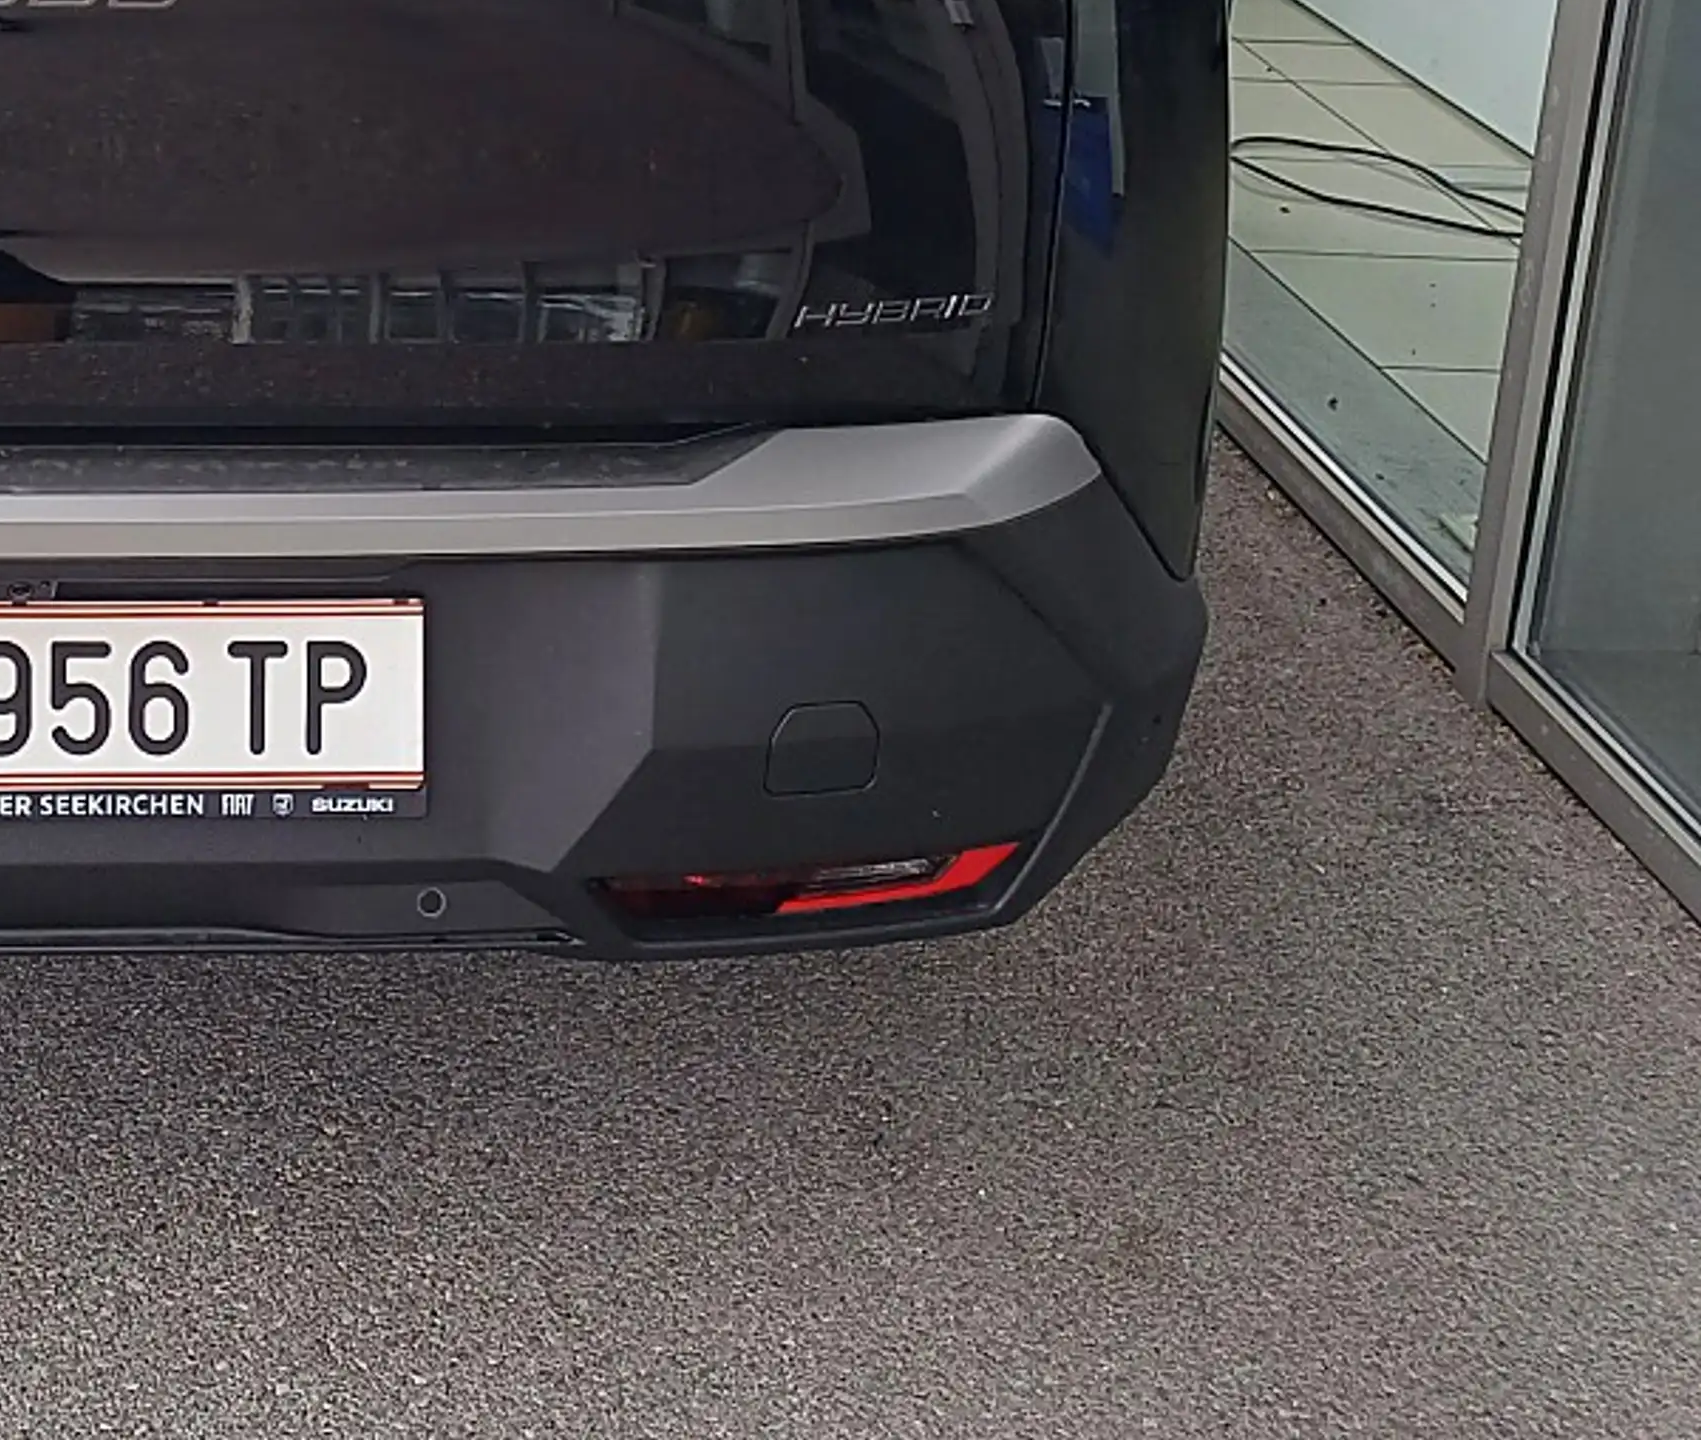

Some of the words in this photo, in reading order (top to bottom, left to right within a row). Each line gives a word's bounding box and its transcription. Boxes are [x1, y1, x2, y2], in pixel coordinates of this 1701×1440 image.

[793, 293, 994, 329] HYBRID
[226, 640, 368, 756] TP
[39, 793, 205, 817] SEEKIRCHEN
[311, 796, 394, 813] SUZUKI
